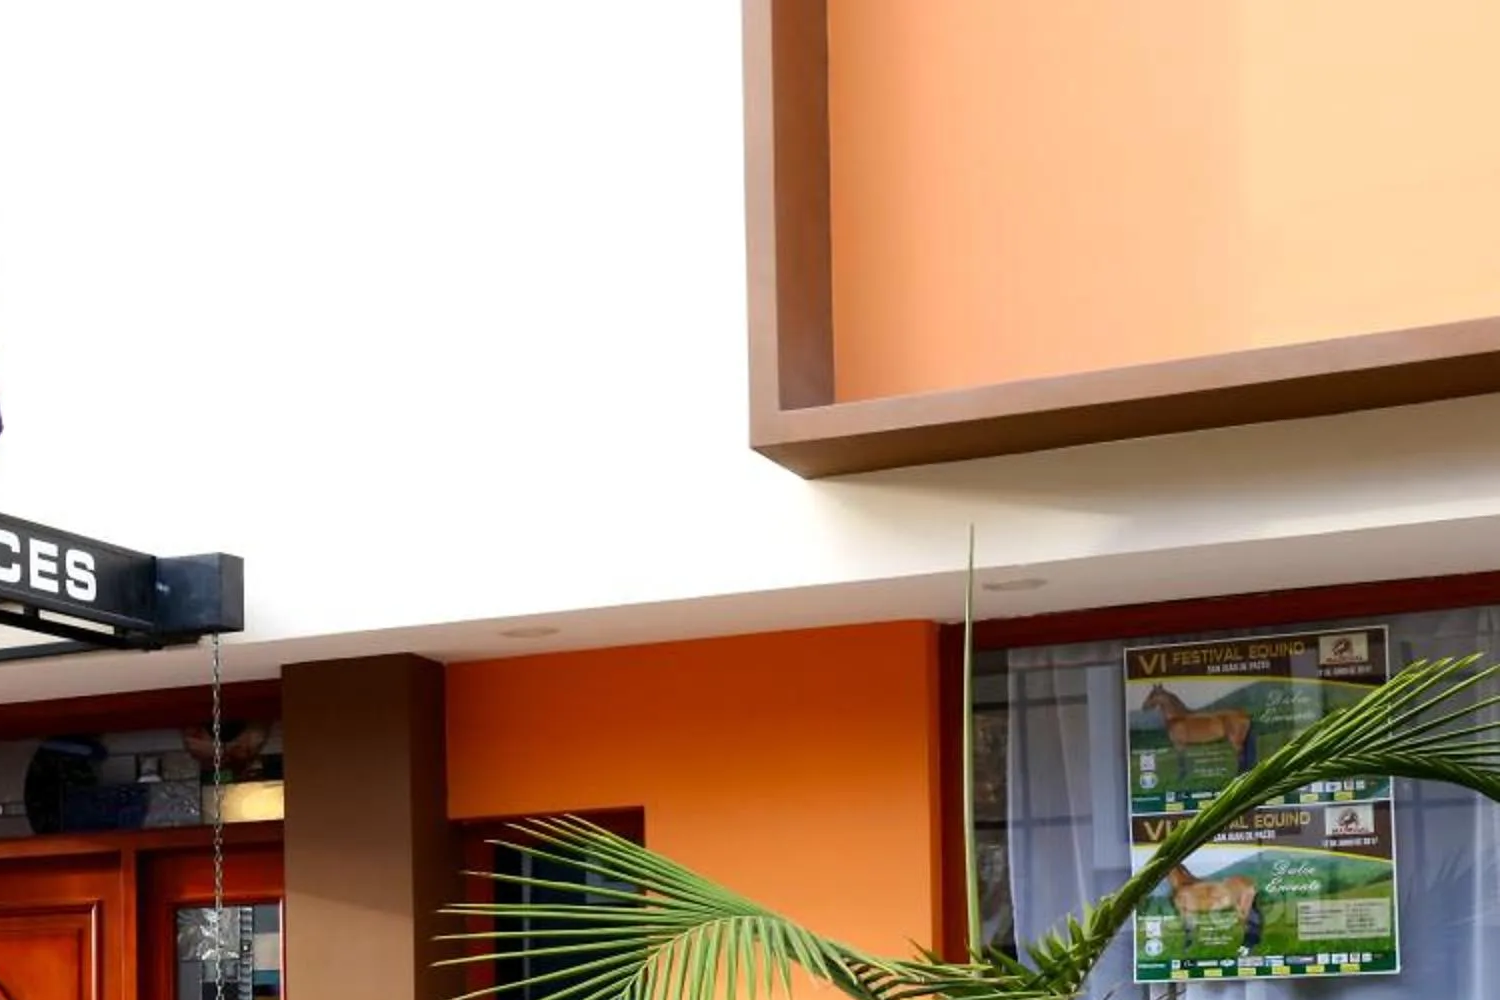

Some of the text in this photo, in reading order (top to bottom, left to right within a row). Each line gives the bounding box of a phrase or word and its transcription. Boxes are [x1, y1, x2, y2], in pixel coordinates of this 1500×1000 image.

[1138, 640, 1307, 675] VI FESTIVAL EQUINO
[1254, 810, 1312, 830] EQUINO
